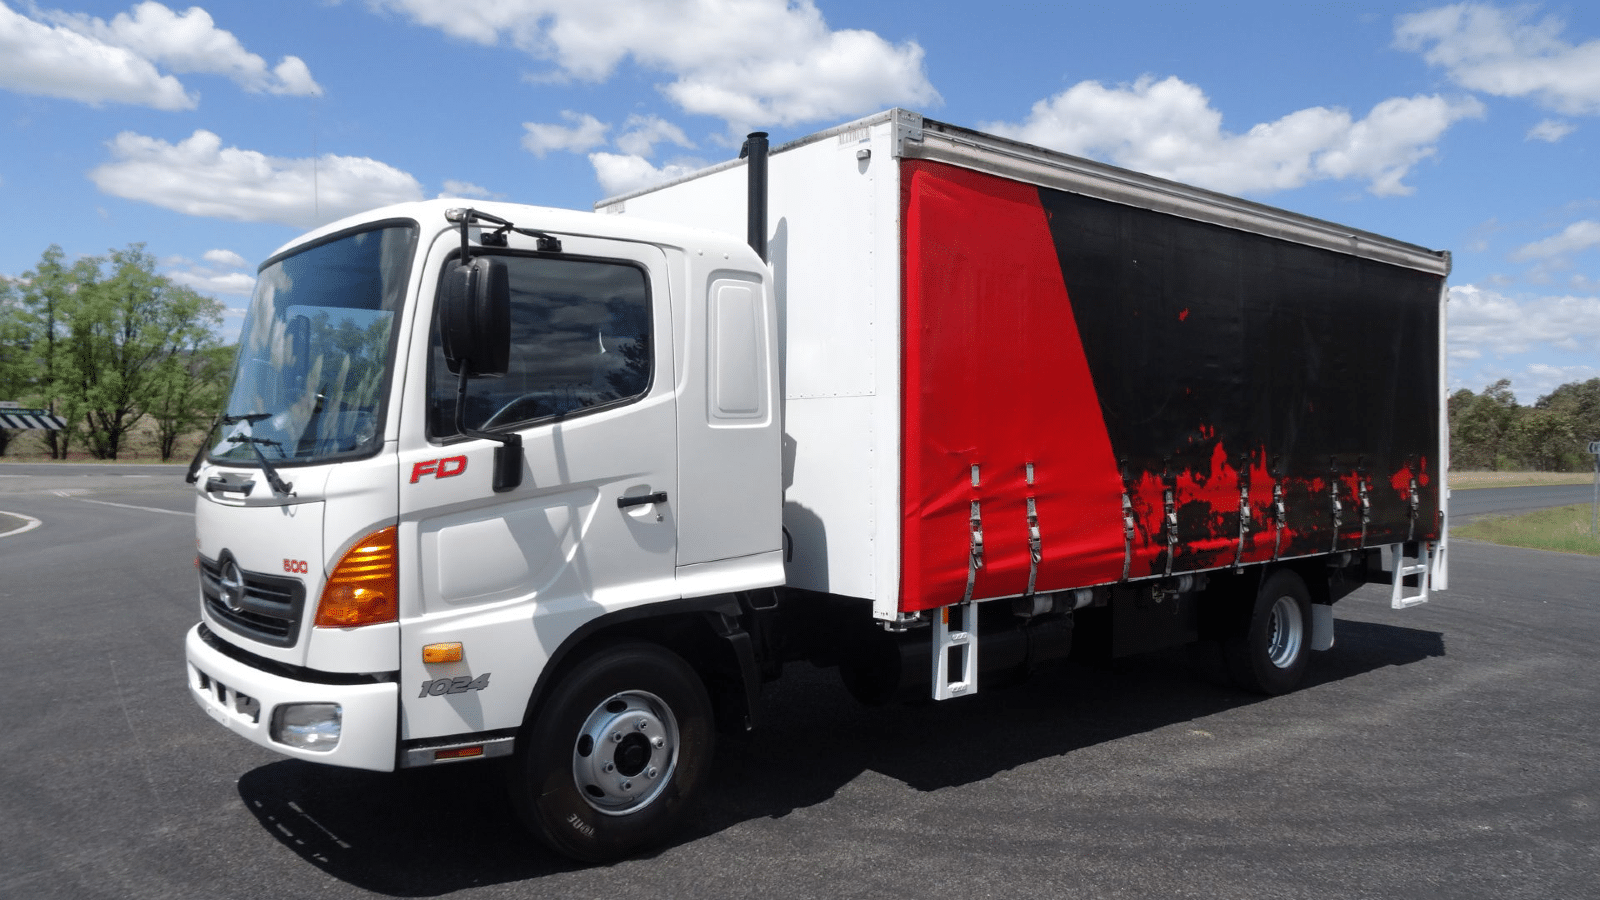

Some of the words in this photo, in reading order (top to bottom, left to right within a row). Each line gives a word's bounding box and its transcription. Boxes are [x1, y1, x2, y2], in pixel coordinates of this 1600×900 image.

[409, 454, 468, 484] FD
[283, 559, 308, 574] 500
[418, 672, 491, 698] 1024
